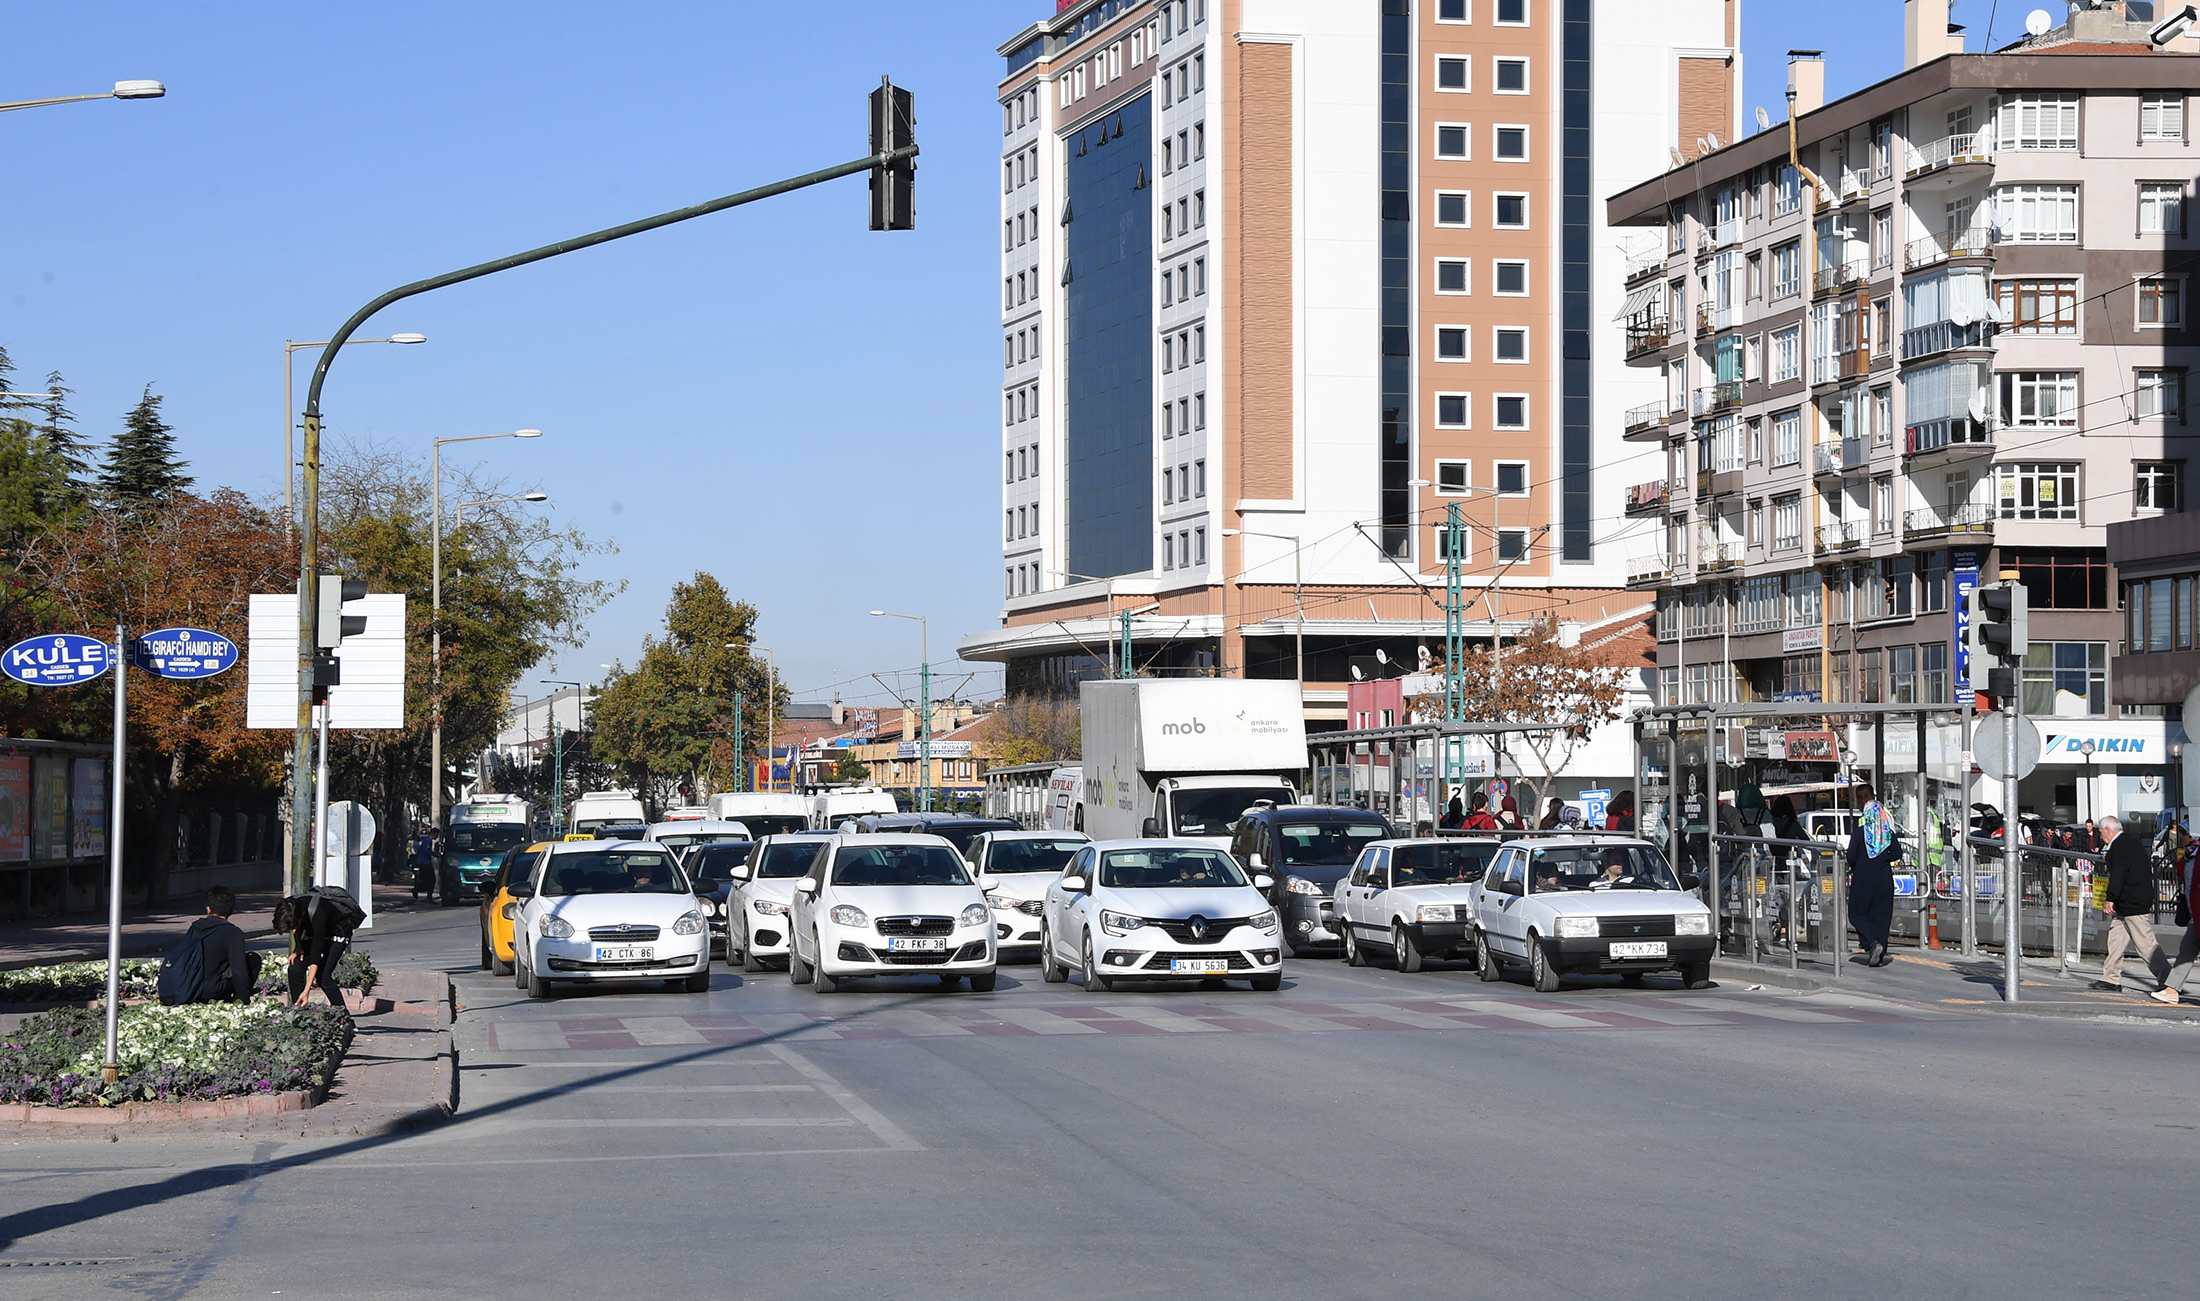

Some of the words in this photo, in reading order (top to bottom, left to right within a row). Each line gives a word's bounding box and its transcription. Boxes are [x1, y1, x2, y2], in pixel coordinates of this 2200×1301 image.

[213, 641, 229, 656] BEY
[13, 645, 103, 666] KULE
[895, 939, 905, 949] 42
[911, 939, 927, 949] FKF
[933, 939, 944, 949] 38
[1612, 944, 1625, 955] 42
[601, 949, 613, 959] 42
[618, 949, 634, 958] CTK
[640, 948, 652, 958] 86
[1177, 961, 1187, 971] 34
[1190, 961, 1201, 971] KU
[1204, 960, 1226, 971] 5636
